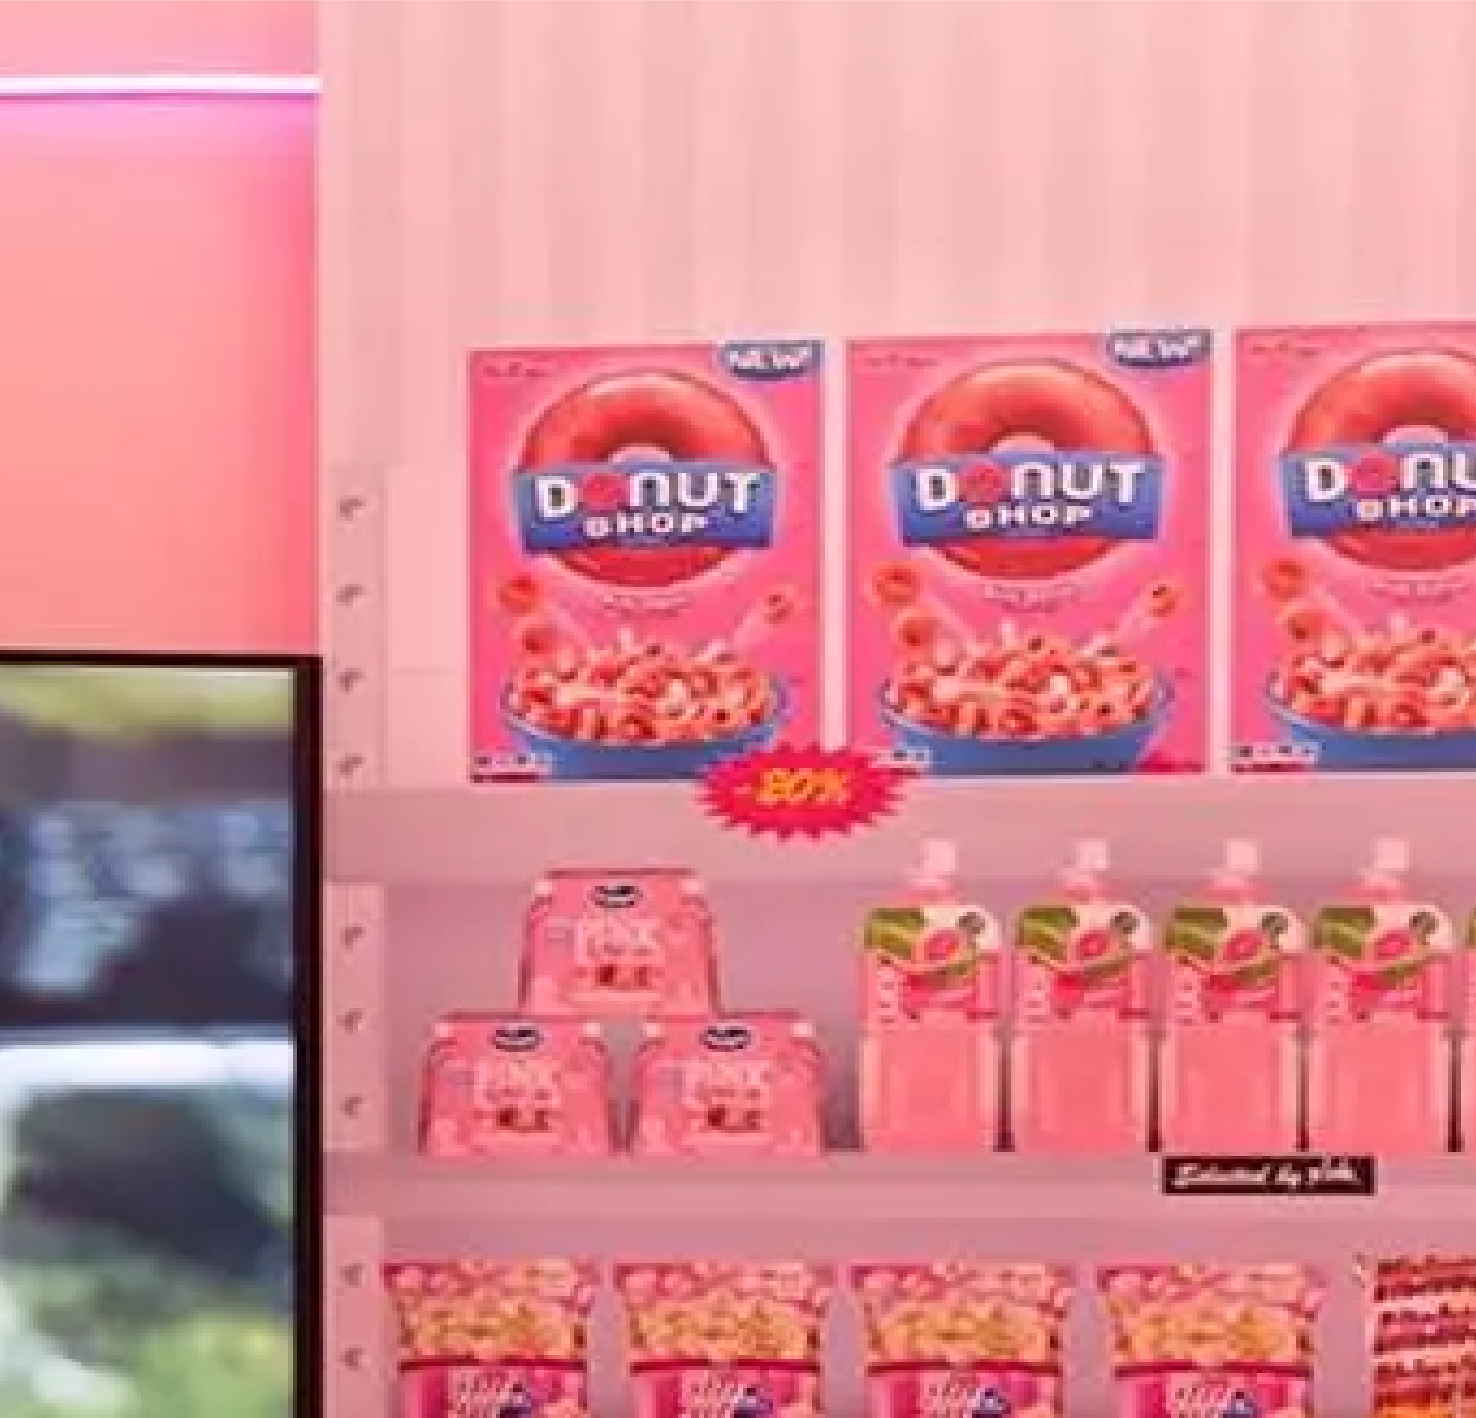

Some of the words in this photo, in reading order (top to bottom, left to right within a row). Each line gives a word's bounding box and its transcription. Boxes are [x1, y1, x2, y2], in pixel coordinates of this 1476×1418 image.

[535, 470, 761, 520] DONUT
[915, 461, 1145, 513] DONUT
[583, 511, 709, 538] SHOP
[964, 505, 1093, 530] SHOP
